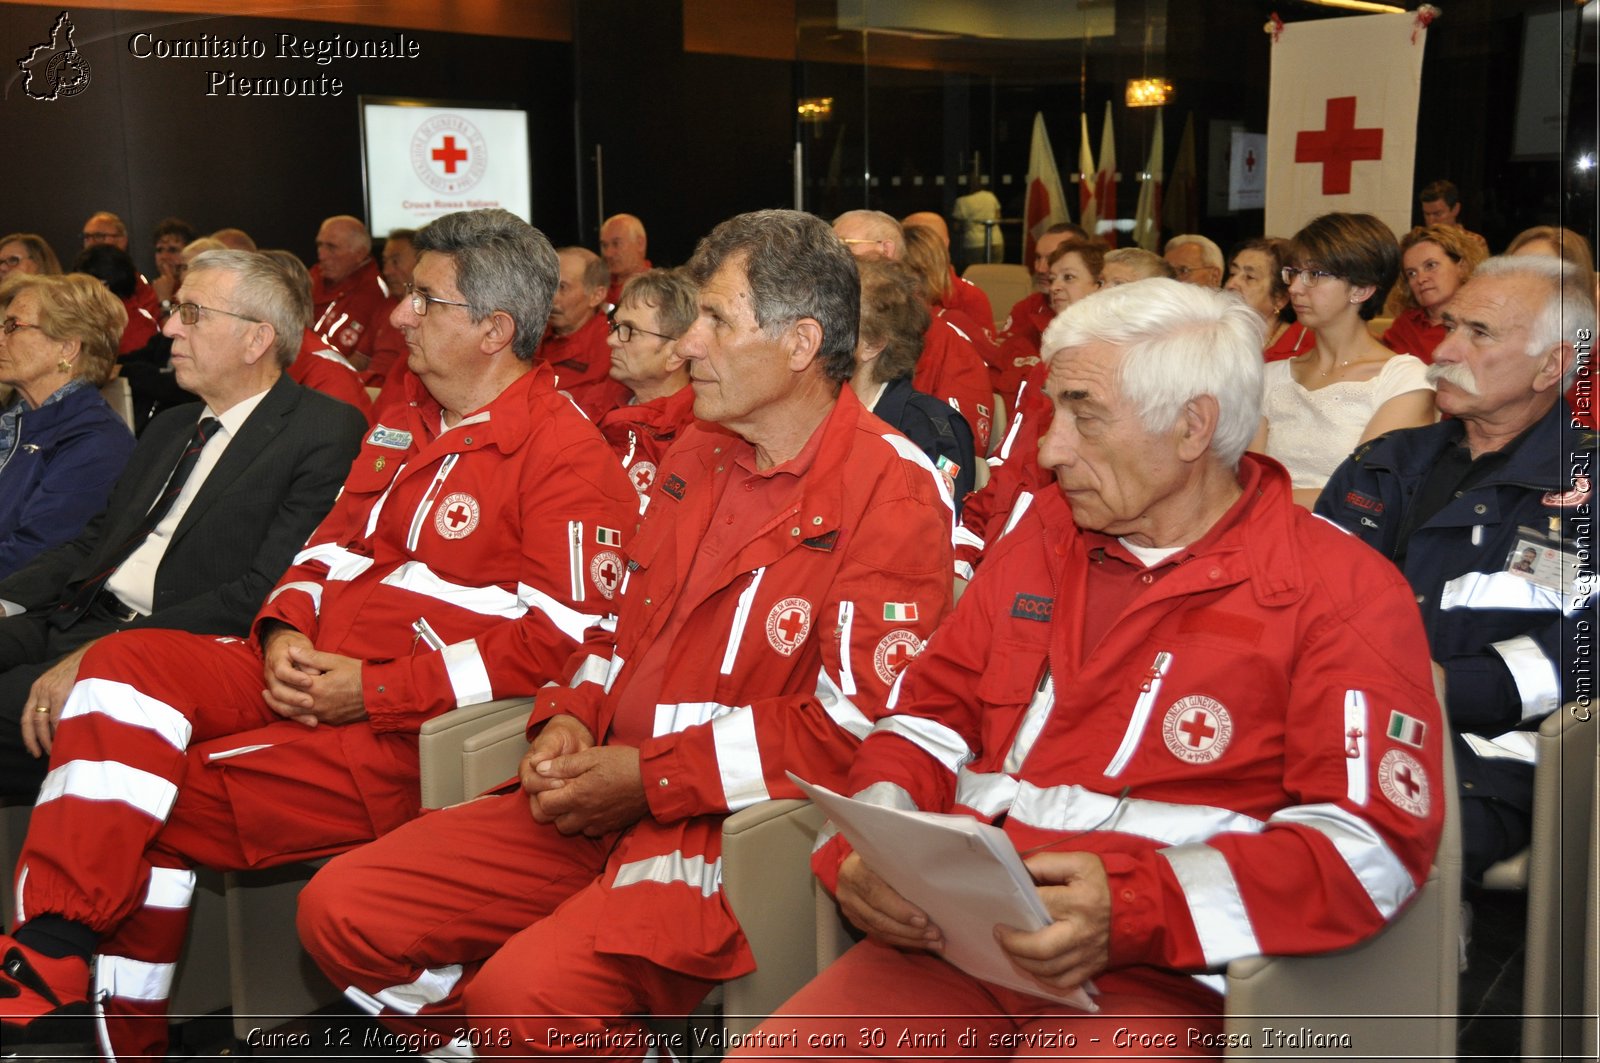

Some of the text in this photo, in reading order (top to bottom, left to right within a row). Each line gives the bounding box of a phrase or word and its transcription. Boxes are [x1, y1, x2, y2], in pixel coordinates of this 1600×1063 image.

[402, 200, 431, 209] Croce
[434, 200, 464, 209] Rossa
[768, 608, 783, 650] CONVENZIONE
[777, 603, 785, 611] DI
[784, 600, 809, 609] GINEVRA
[876, 646, 894, 684] ONVENZIONE
[888, 632, 912, 641] GINEVRA
[1164, 696, 1230, 761] CONVENZIONE DI GINEVRA 22 AGOSTO 1864
